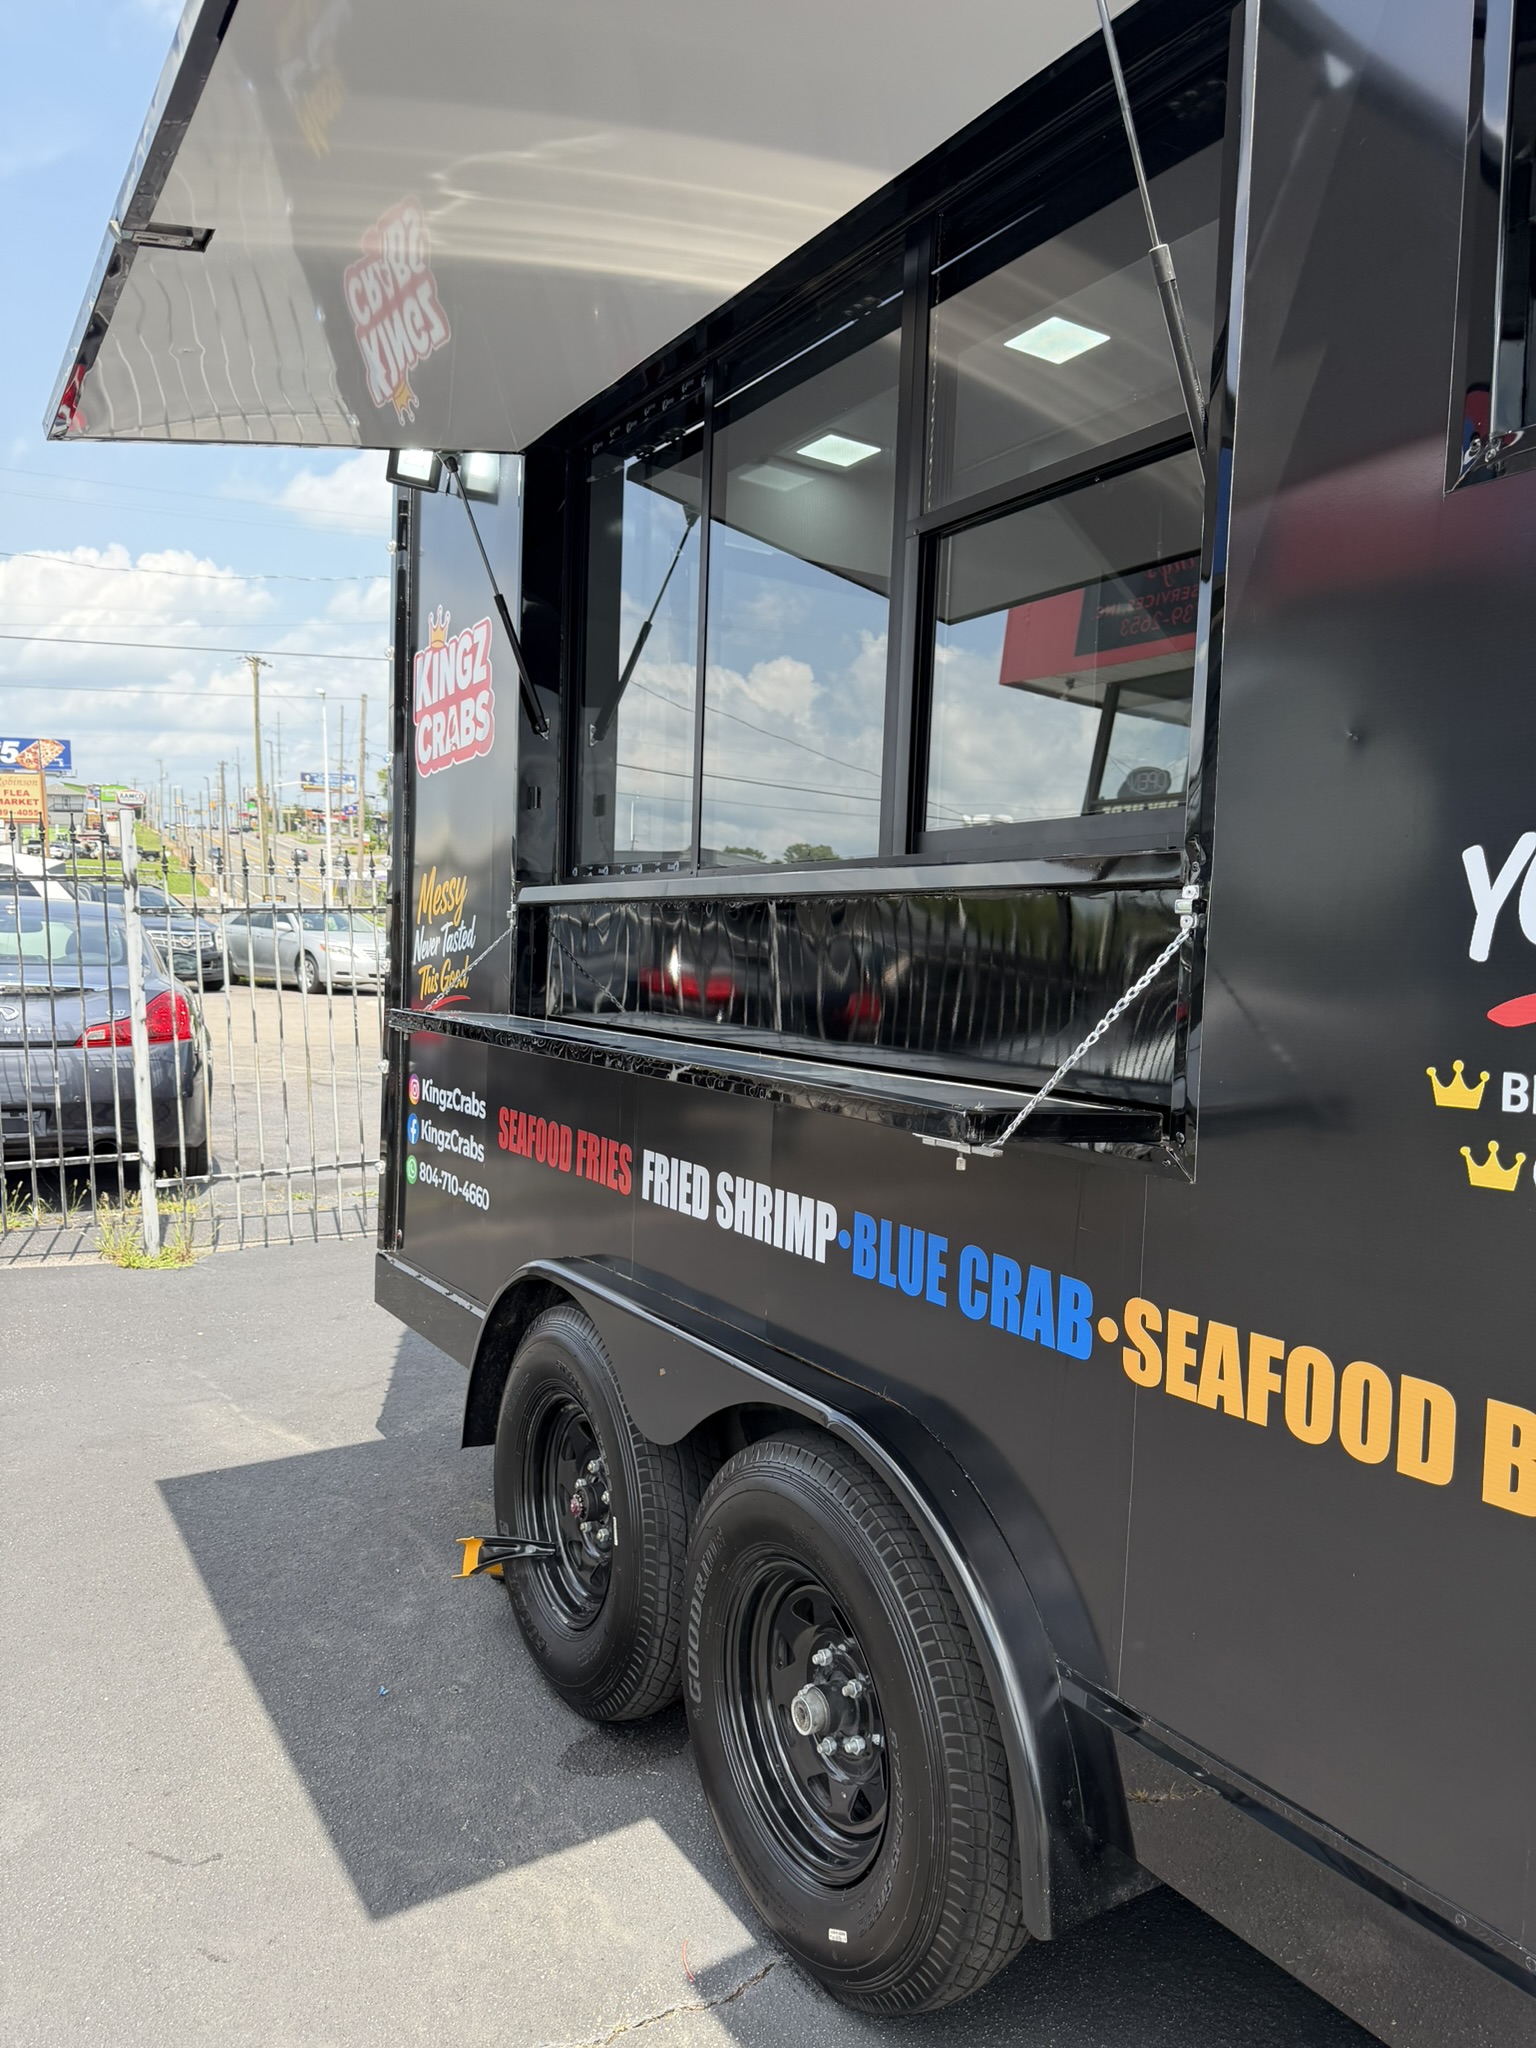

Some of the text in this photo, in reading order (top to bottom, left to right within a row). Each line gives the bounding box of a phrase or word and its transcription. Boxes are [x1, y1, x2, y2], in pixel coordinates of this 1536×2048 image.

[416, 624, 488, 713] KINGZ
[0, 741, 20, 764] 5
[418, 690, 490, 765] CRABS
[416, 866, 468, 926] Messy
[412, 915, 476, 966] Never Tasted
[418, 955, 470, 1000] This Good
[422, 1078, 487, 1119] KingzCrabs
[421, 1119, 485, 1163] KingzCrabs
[419, 1161, 490, 1211] 804-710-4660
[498, 1106, 572, 1173] SEAFOOD
[575, 1128, 633, 1196] FRIES
[641, 1148, 710, 1221] FRIED
[715, 1170, 838, 1264] SHRIMP
[852, 1210, 948, 1307] BLUE
[958, 1244, 1094, 1361] CRAB
[1122, 1296, 1457, 1487] SEAFOOD
